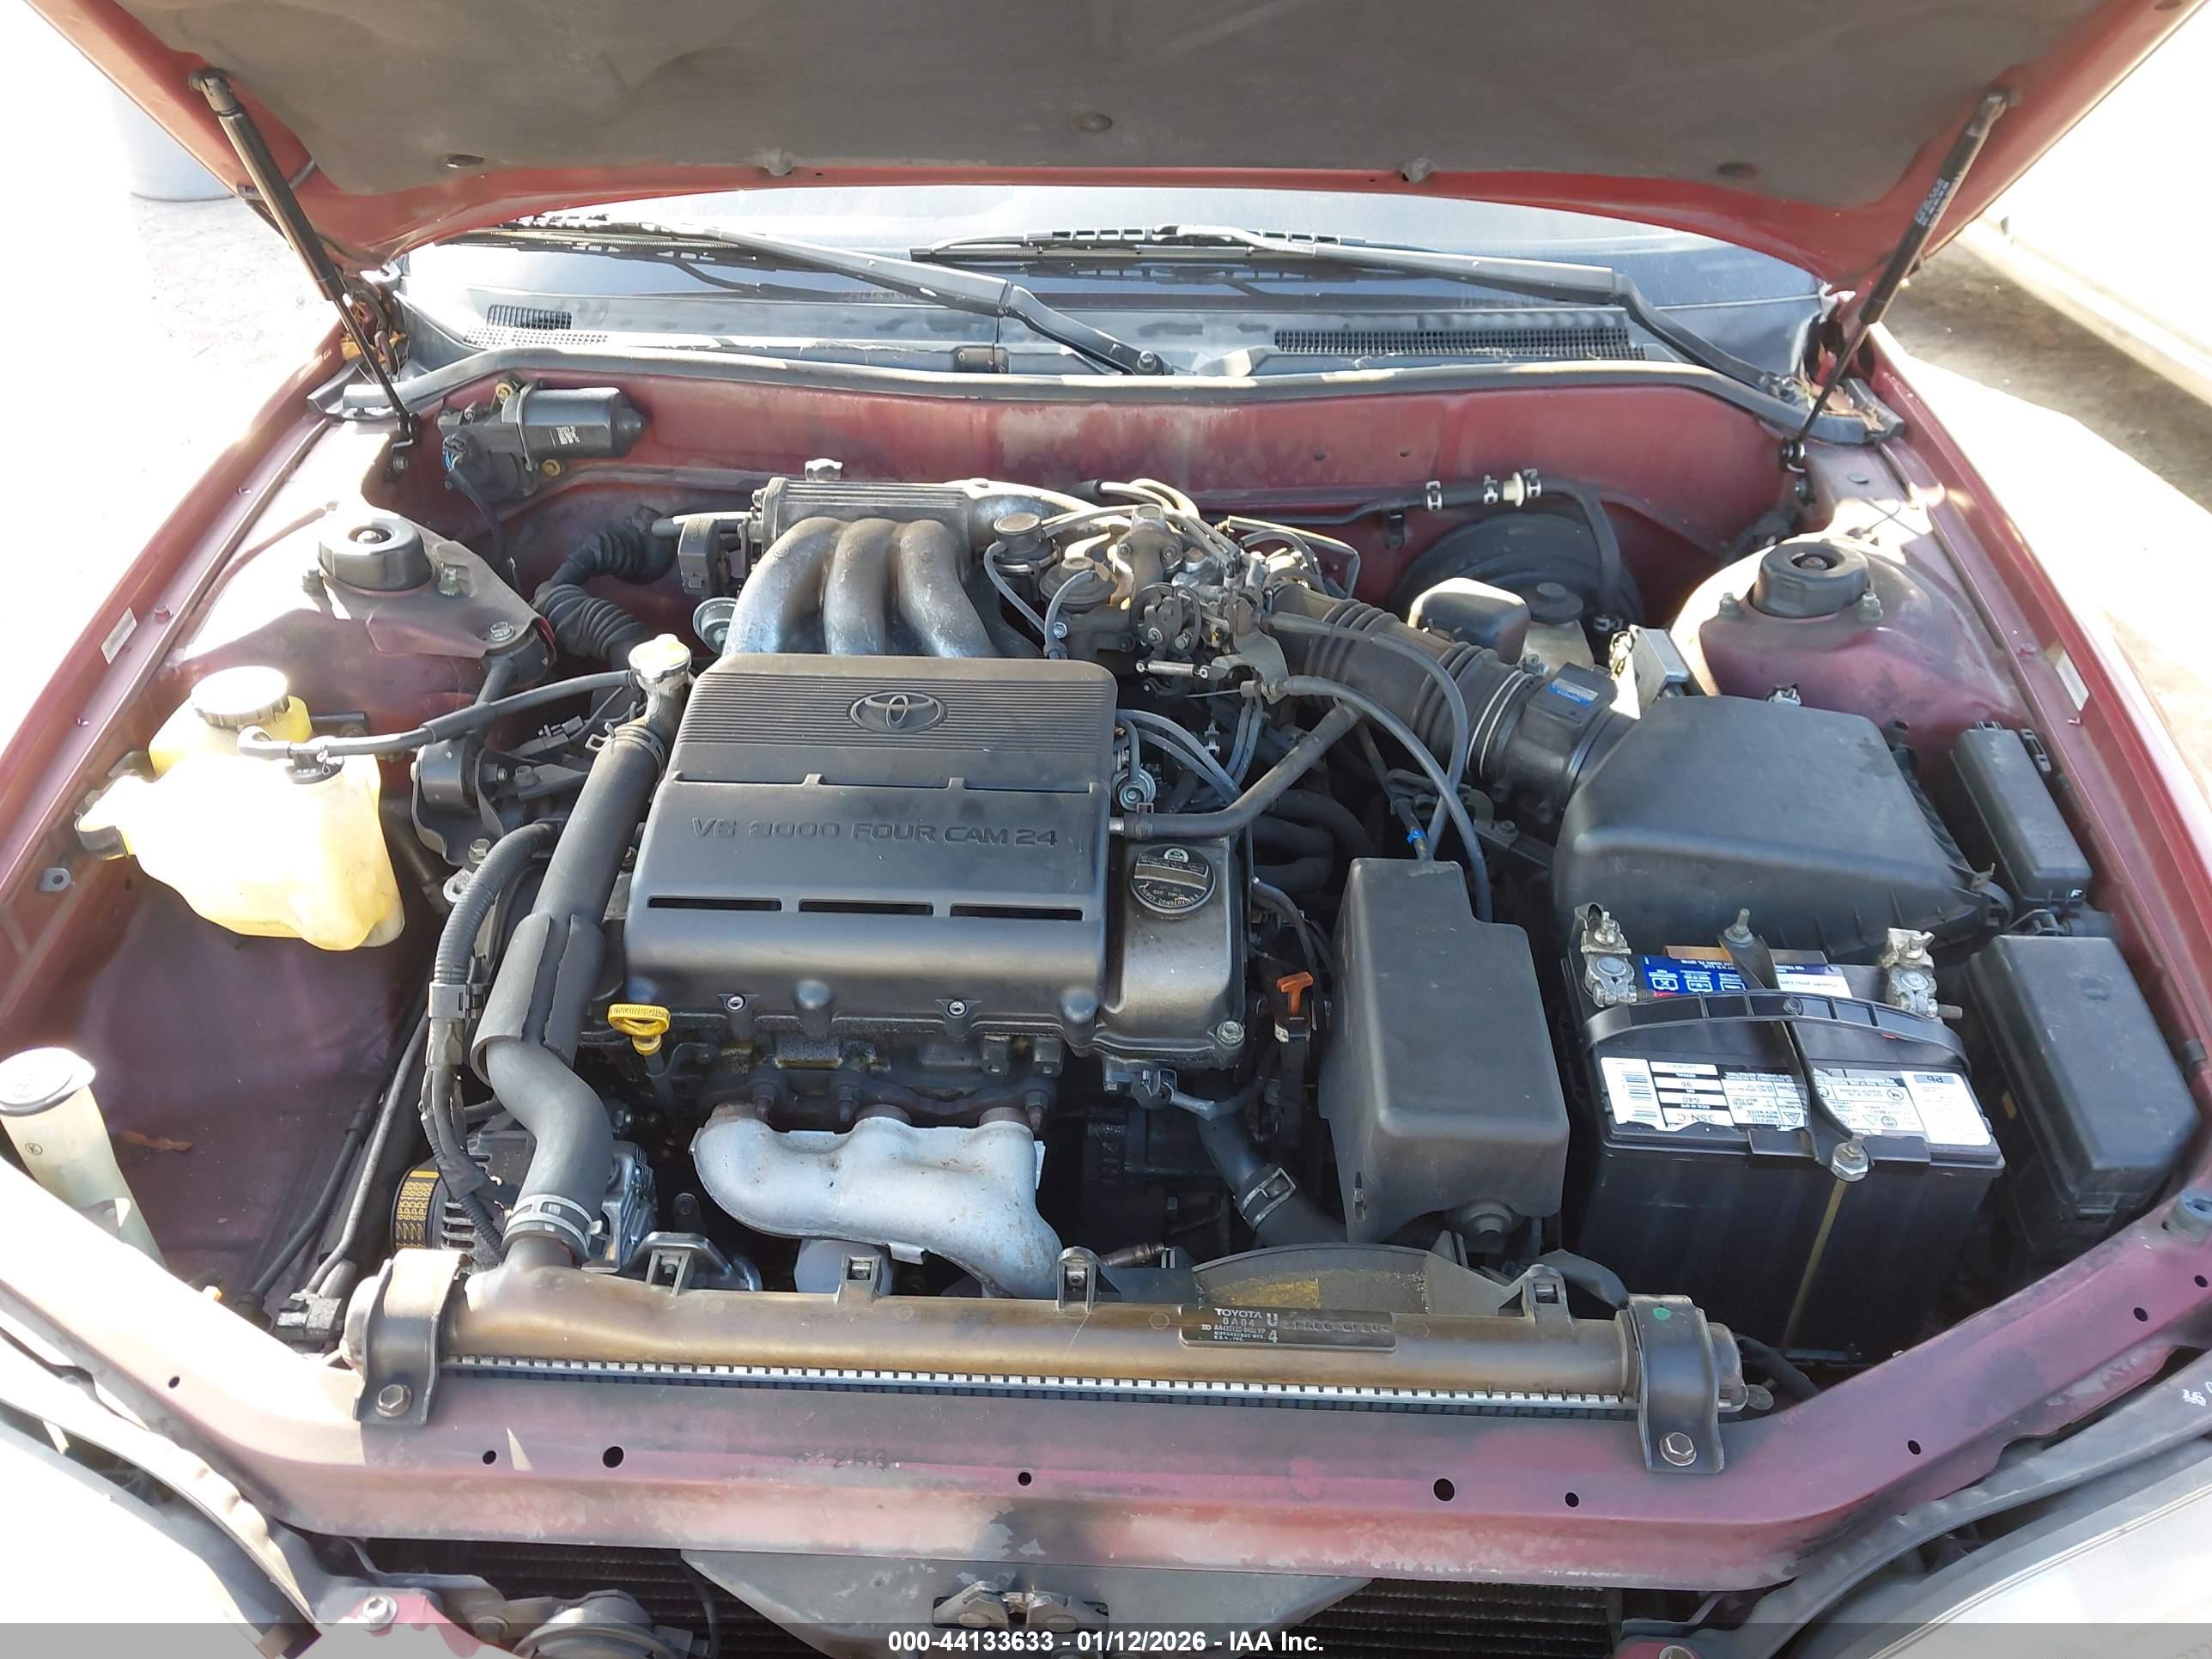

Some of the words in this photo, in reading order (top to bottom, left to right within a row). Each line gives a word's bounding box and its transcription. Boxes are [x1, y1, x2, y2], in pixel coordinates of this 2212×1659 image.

[690, 817, 737, 839] V6
[748, 818, 840, 840] 3000
[850, 822, 936, 842] FOUR
[944, 825, 1008, 845] CAM
[1014, 829, 1058, 846] 24
[647, 1008, 662, 1017] OIL
[1213, 1307, 1263, 1320] TOYOTA
[1266, 1312, 1279, 1328] U
